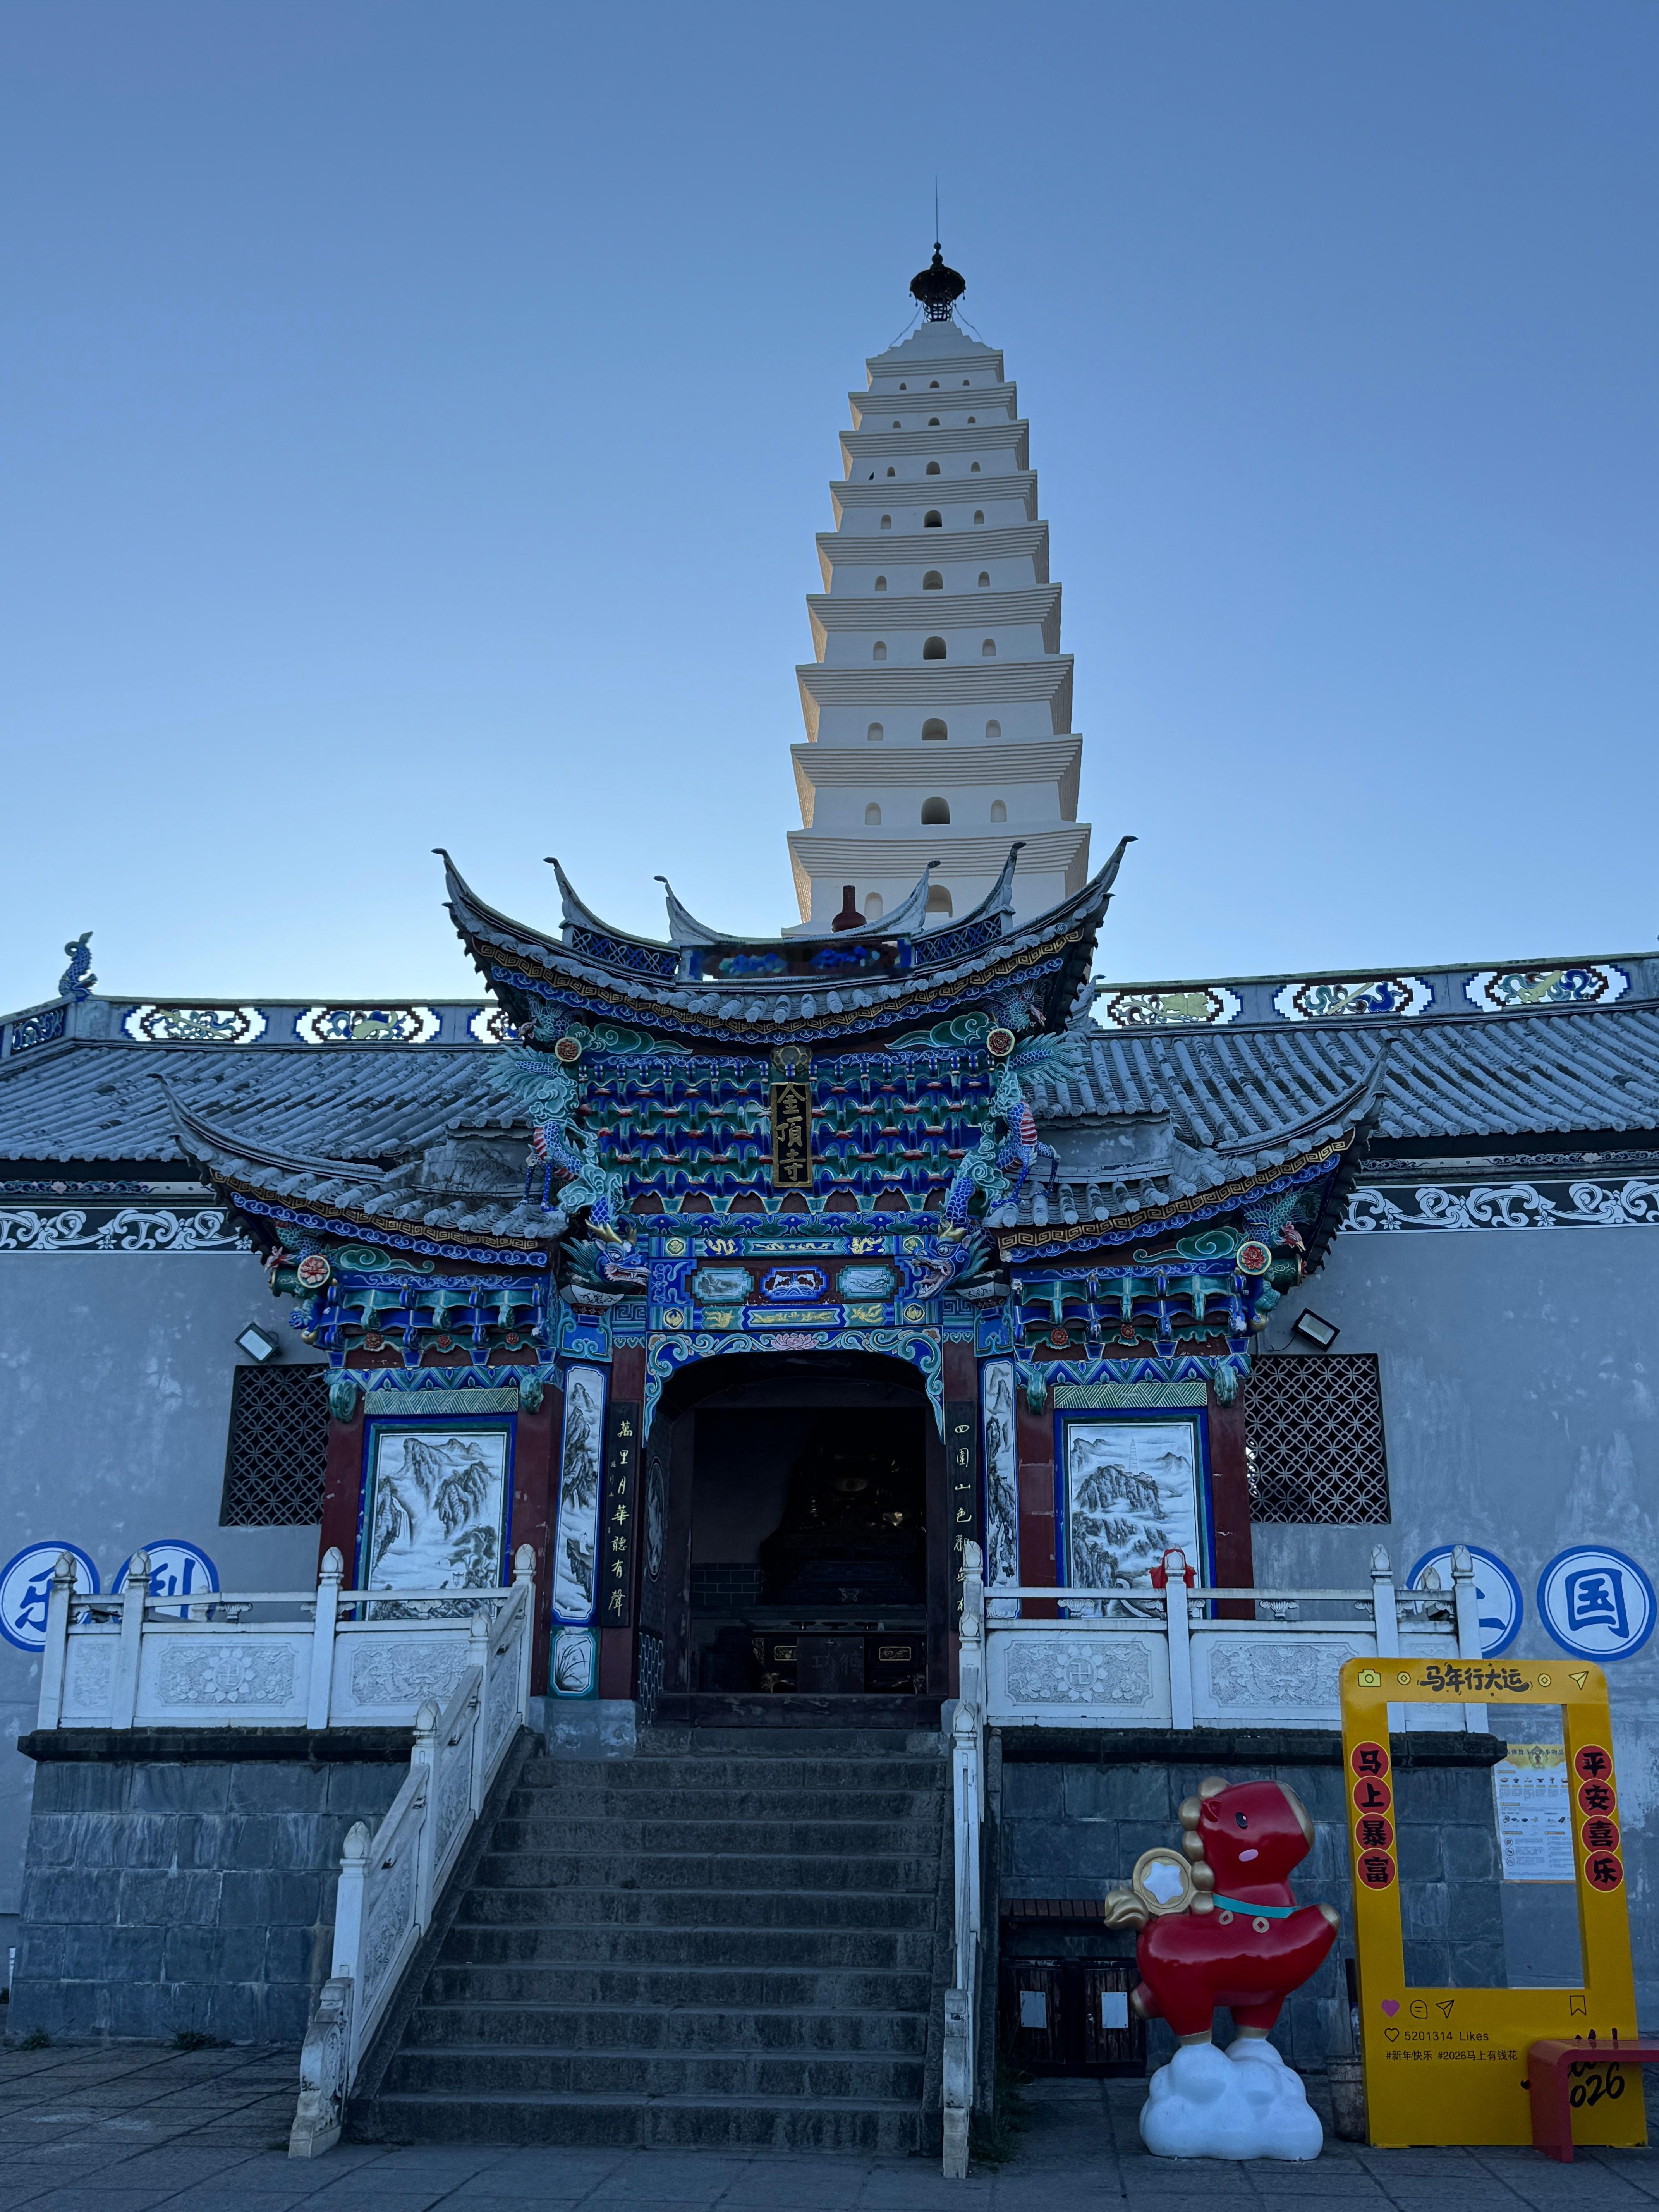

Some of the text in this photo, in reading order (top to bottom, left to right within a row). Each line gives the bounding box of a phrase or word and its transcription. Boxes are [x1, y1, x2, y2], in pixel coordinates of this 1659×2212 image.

[775, 1083, 807, 1181] 金頂寺
[608, 1420, 633, 1617] 萬里月華聽有聲
[1565, 1568, 1630, 1638] 国
[1420, 1664, 1530, 1692] 马年行大运
[1358, 1750, 1389, 1883] 马上暴富
[1582, 1752, 1617, 1883] 平安喜乐
[1386, 2050, 1518, 2061] #新年快乐 #2026马上有钱花
[1405, 2031, 1489, 2041] 5201314 Likes
